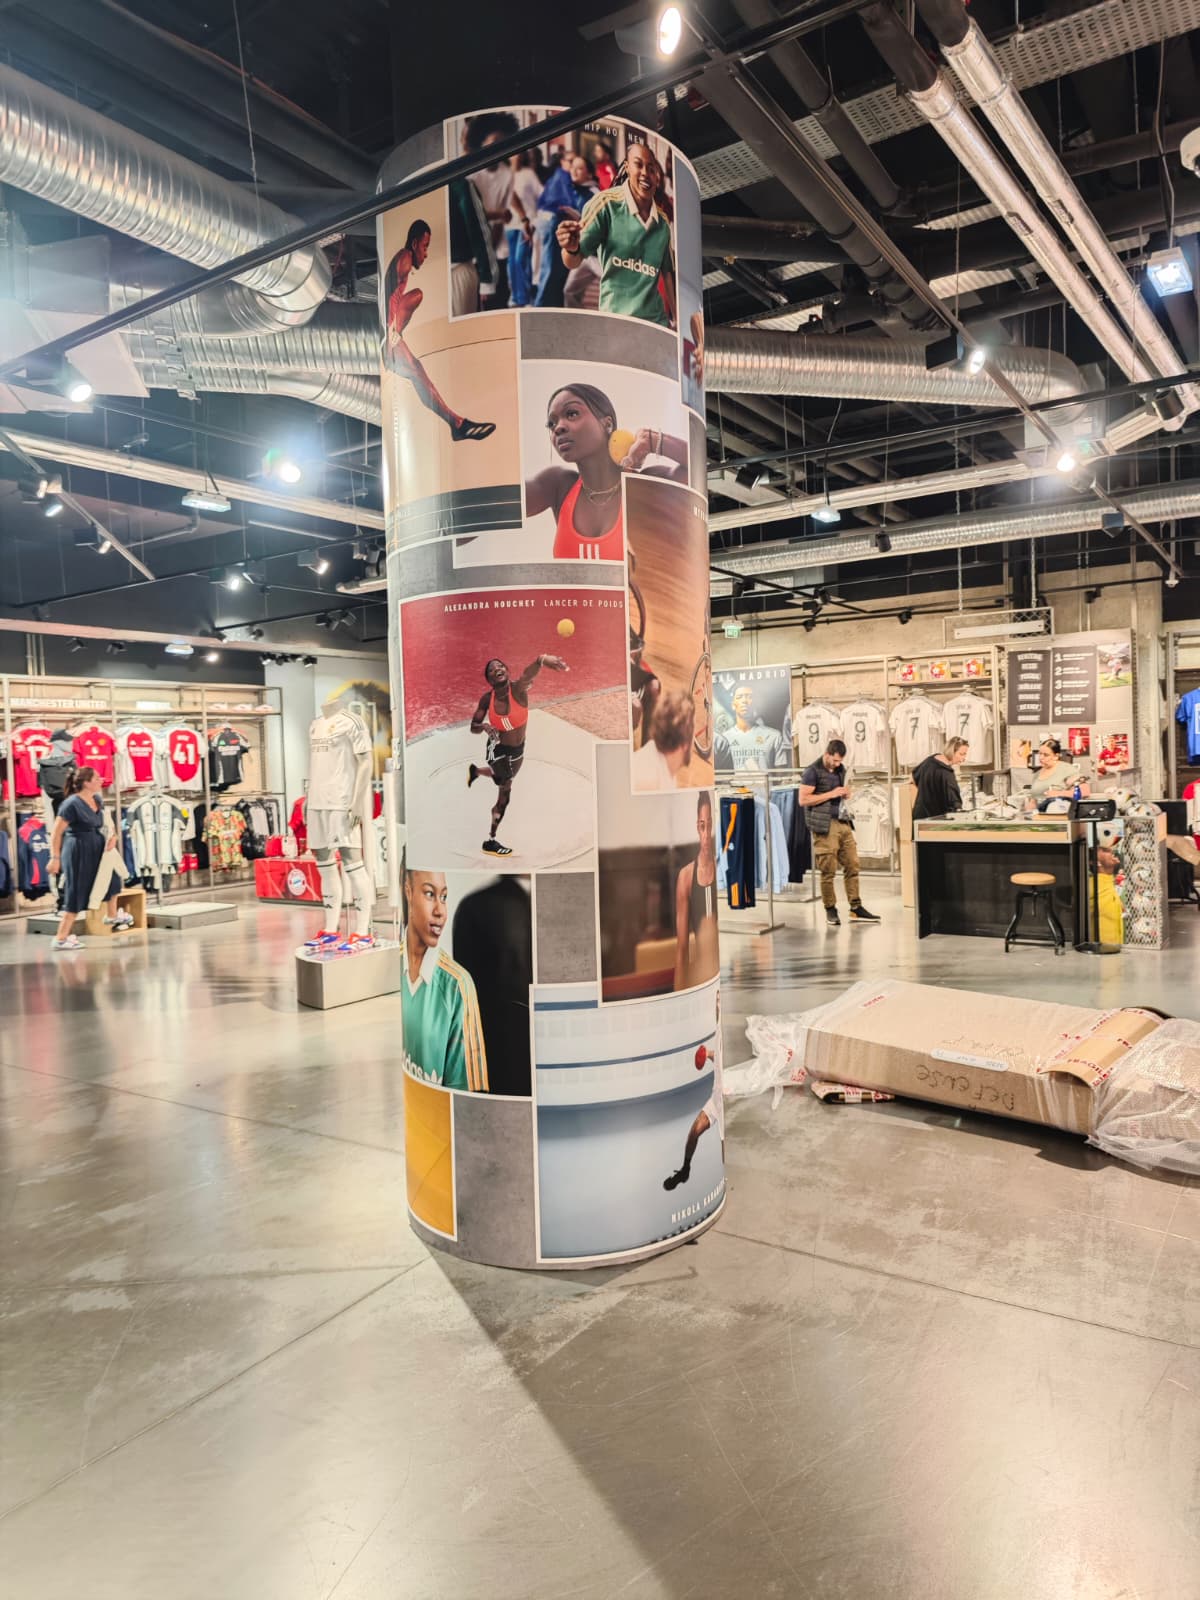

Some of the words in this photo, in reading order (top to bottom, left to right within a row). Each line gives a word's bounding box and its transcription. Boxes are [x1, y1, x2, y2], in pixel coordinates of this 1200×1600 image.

[612, 256, 656, 277] adidas
[444, 602, 490, 612] ALEXANDRA
[544, 599, 578, 607] LANCER
[582, 599, 593, 607] DE
[598, 599, 623, 608] POIDS
[1054, 653, 1062, 662] 1
[739, 669, 786, 681] MADRID
[1054, 667, 1062, 676] 2
[1054, 706, 1062, 716] 5
[808, 722, 820, 744] 9
[855, 721, 866, 742] 9
[910, 717, 919, 740] 7
[960, 713, 970, 737] 7
[173, 743, 195, 765] 41
[671, 1202, 700, 1224] NIKOLA
